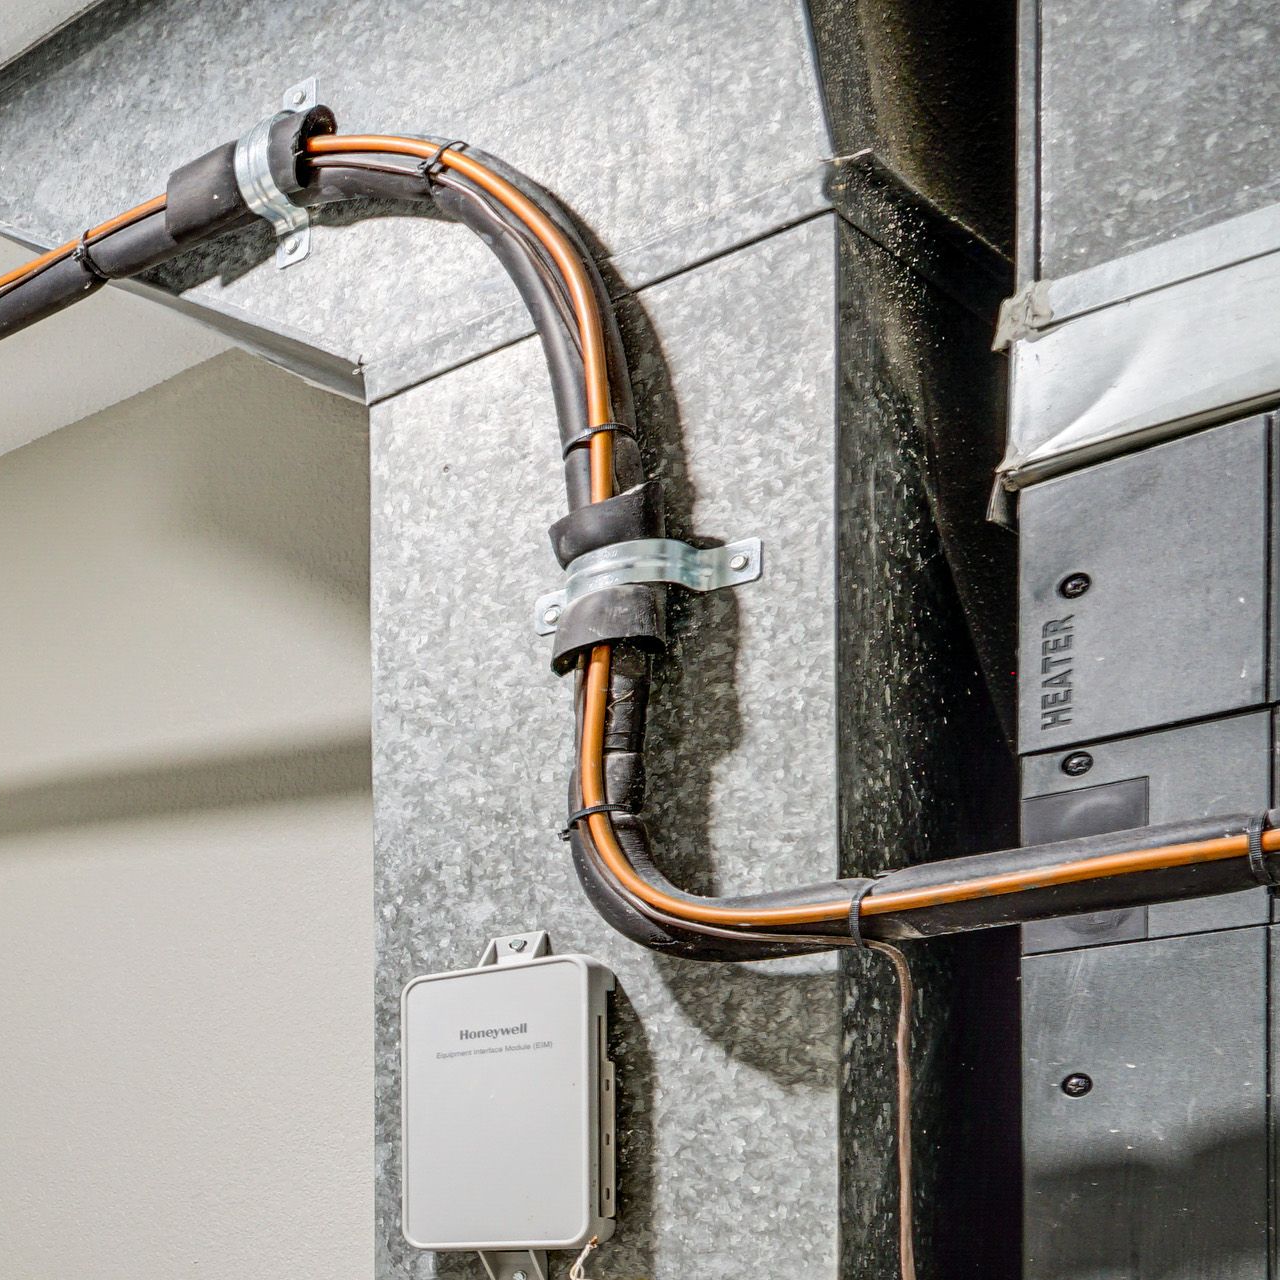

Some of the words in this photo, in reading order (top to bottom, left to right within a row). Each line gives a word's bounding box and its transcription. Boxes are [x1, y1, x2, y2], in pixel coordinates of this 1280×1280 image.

[1041, 613, 1075, 731] HEATER
[460, 1023, 527, 1040] Honeywell
[436, 1050, 472, 1059] Equipment
[474, 1047, 503, 1055] Interface
[505, 1043, 531, 1052] Module
